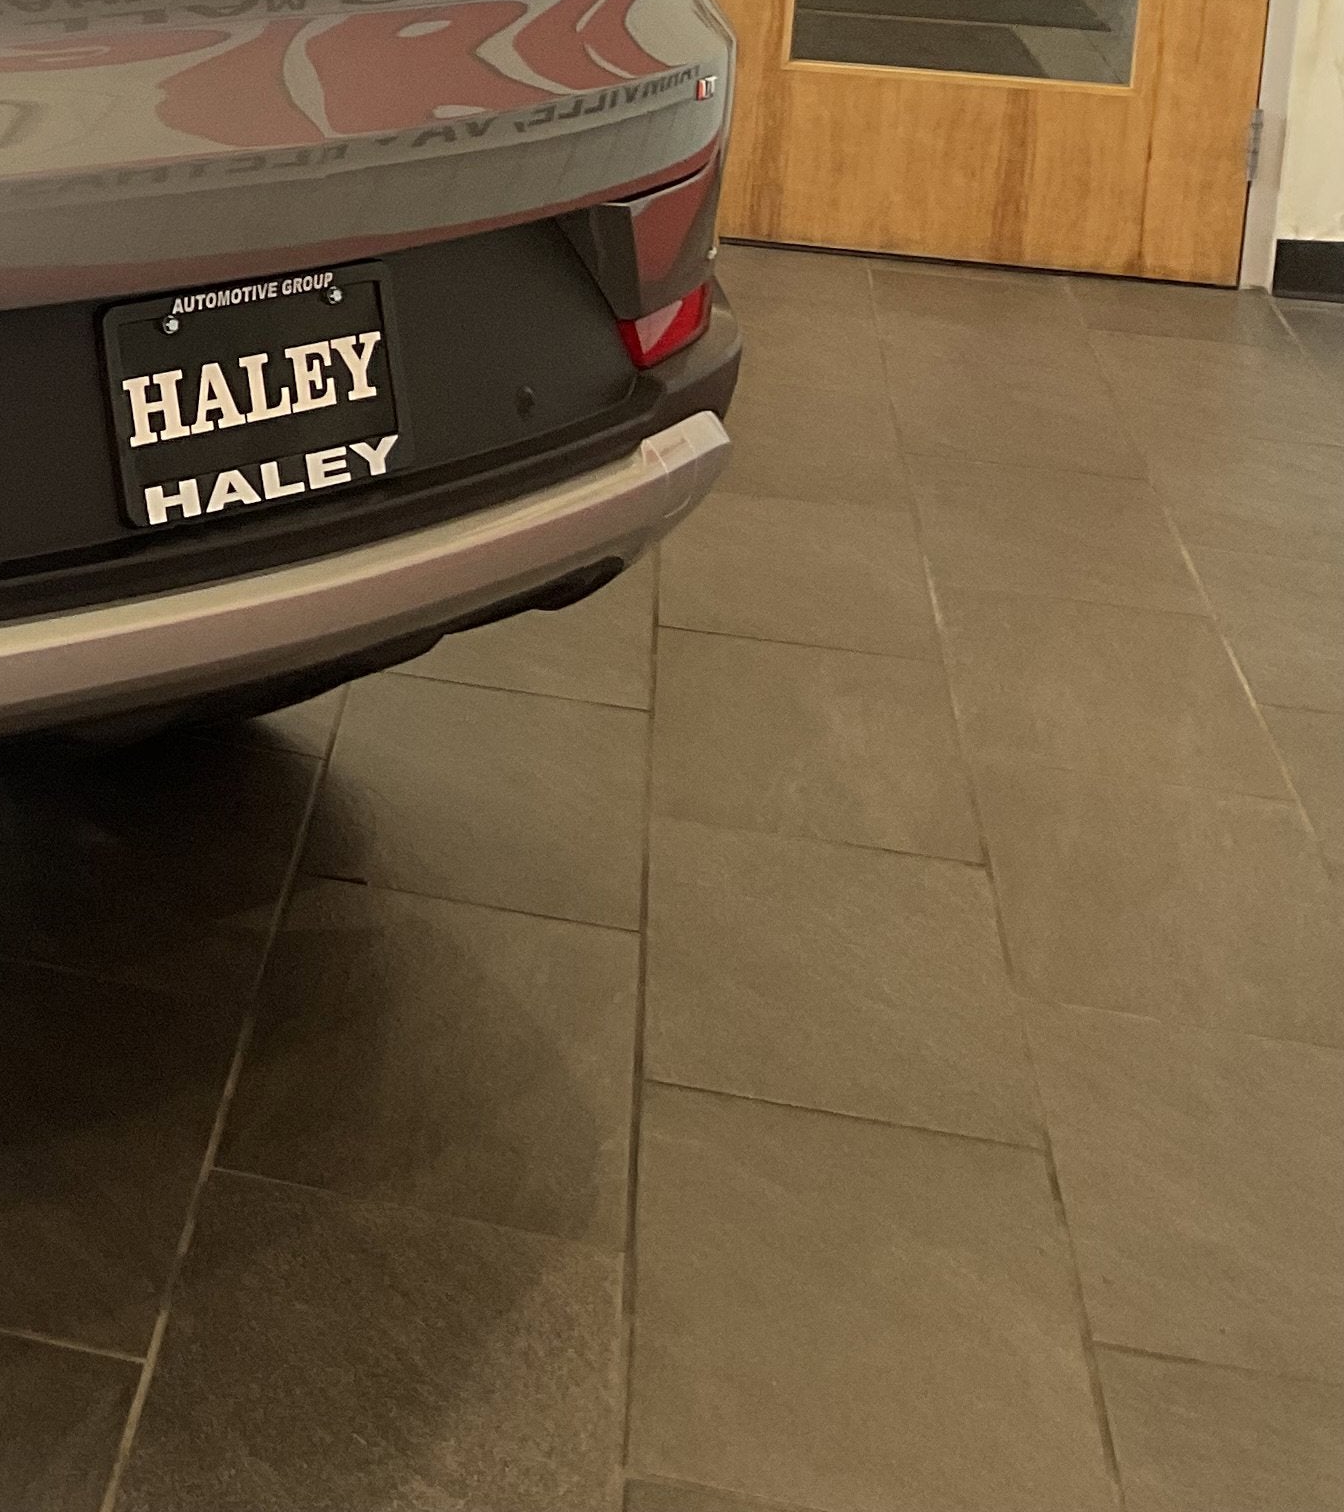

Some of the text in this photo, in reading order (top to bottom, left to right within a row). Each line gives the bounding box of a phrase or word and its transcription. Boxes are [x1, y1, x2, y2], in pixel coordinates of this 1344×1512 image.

[172, 271, 334, 315] AUTOMOTIVE GROUP
[122, 330, 381, 448] HALEY
[144, 434, 399, 526] HALEY
